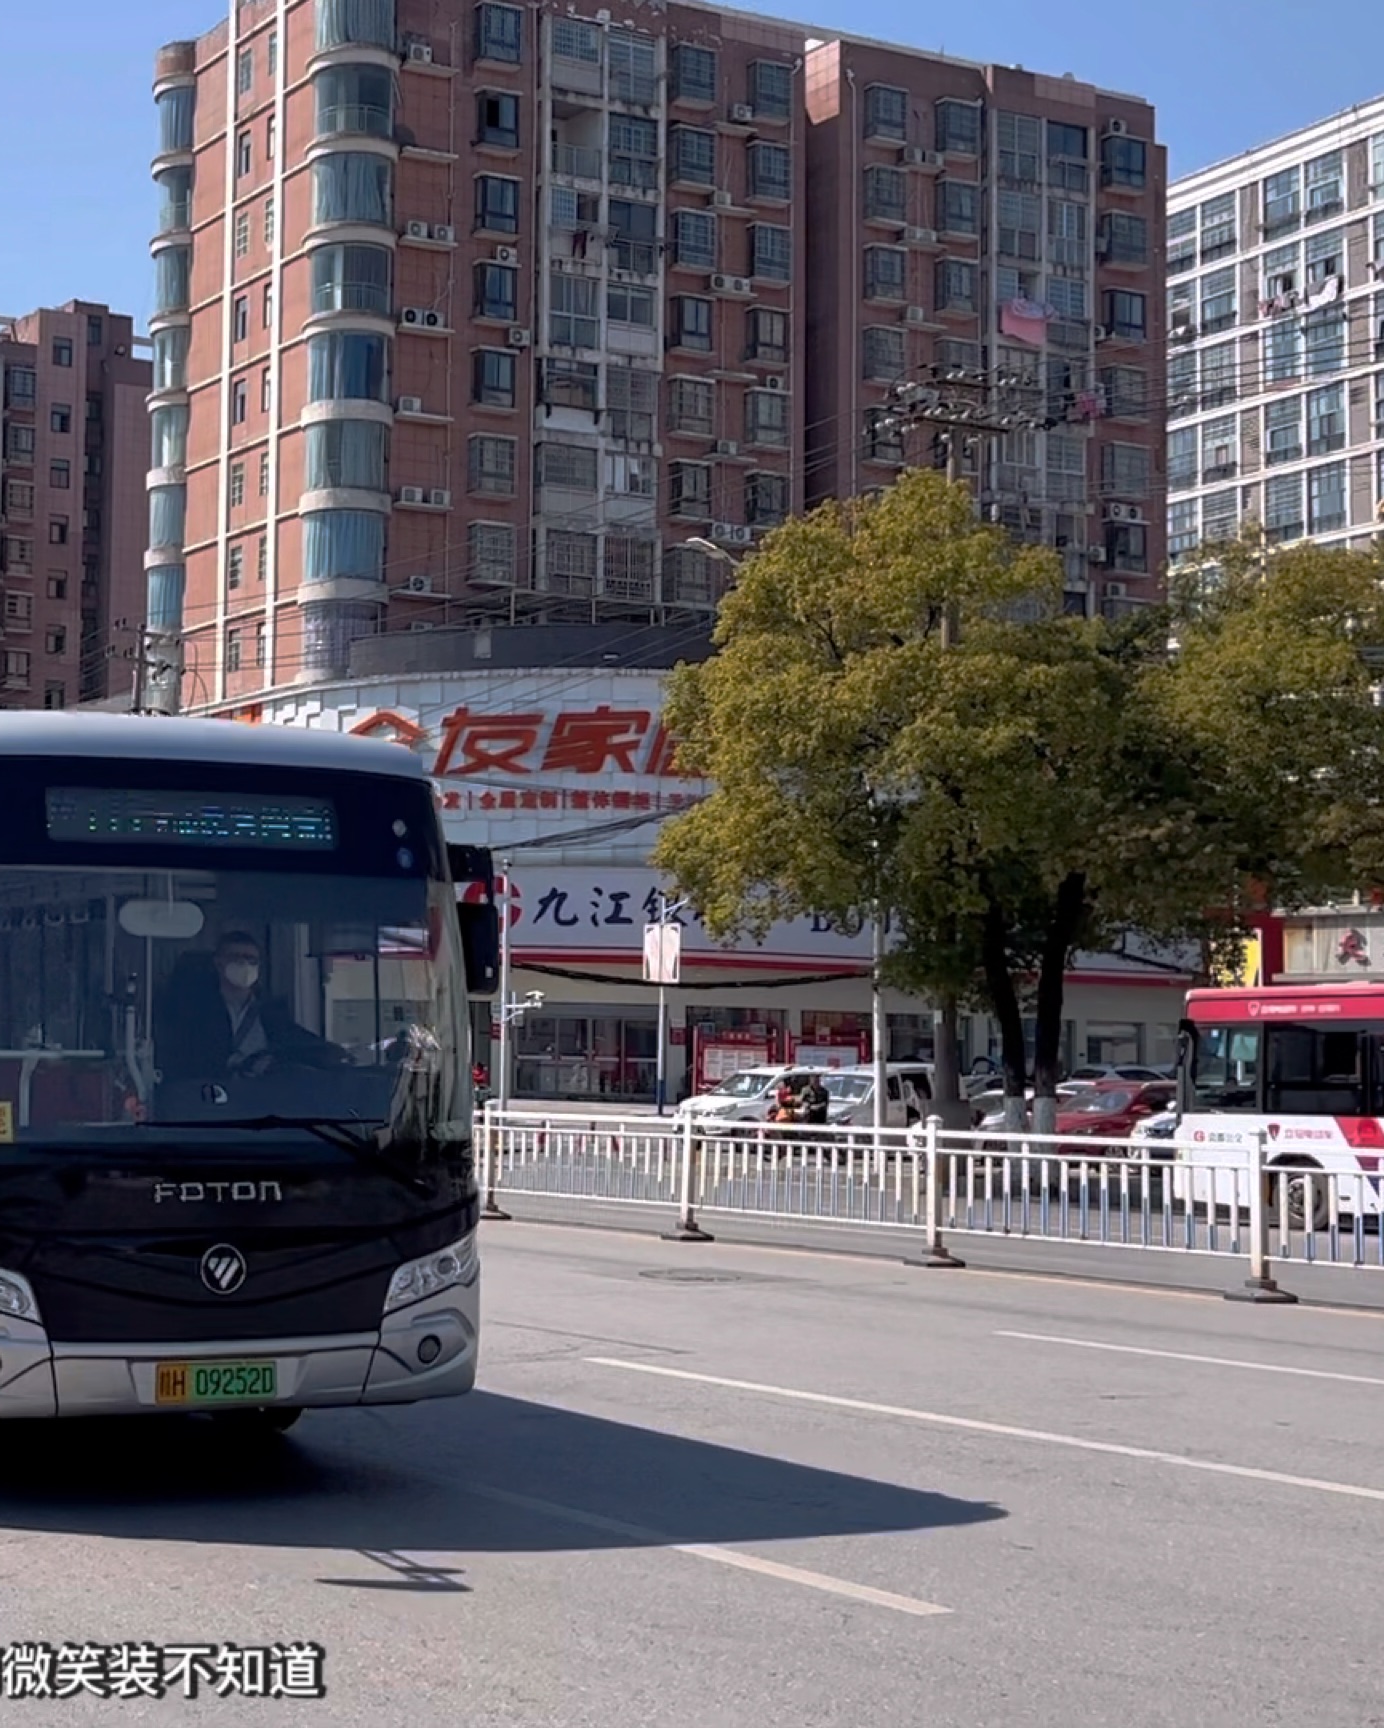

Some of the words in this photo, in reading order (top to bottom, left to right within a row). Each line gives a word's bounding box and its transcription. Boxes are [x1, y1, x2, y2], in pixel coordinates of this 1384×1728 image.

[533, 886, 704, 927] 九江银
[154, 1181, 283, 1203] FOTON
